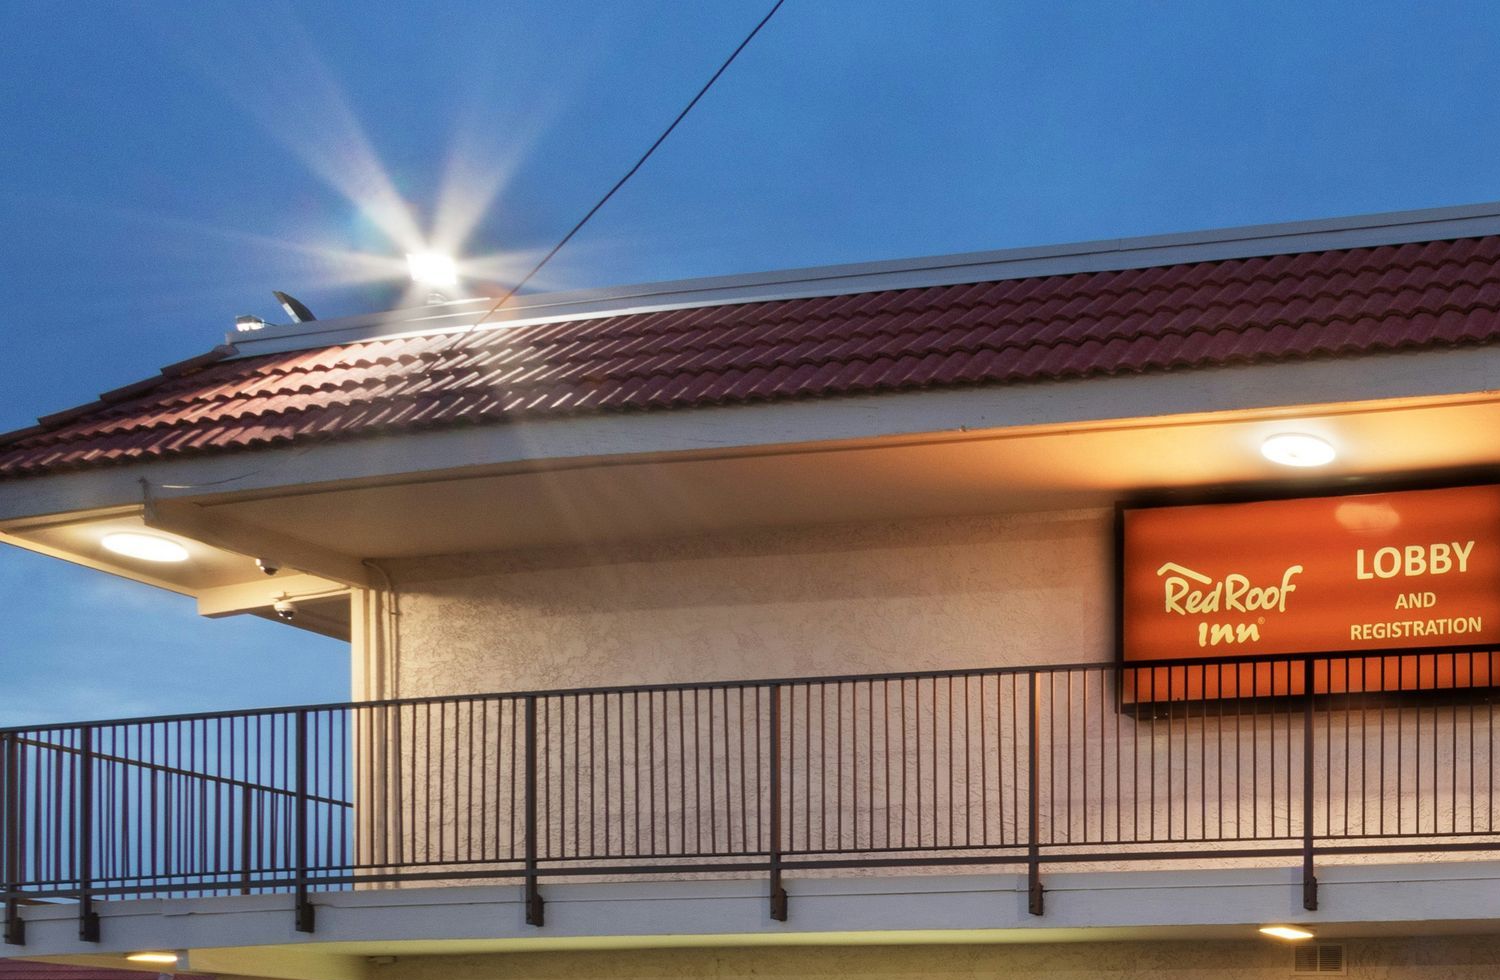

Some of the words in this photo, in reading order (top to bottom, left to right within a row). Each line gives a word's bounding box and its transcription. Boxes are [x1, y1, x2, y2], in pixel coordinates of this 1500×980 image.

[1356, 541, 1475, 580] LOBBY
[1394, 592, 1437, 610] AND
[1350, 617, 1482, 641] REGISTRATION
